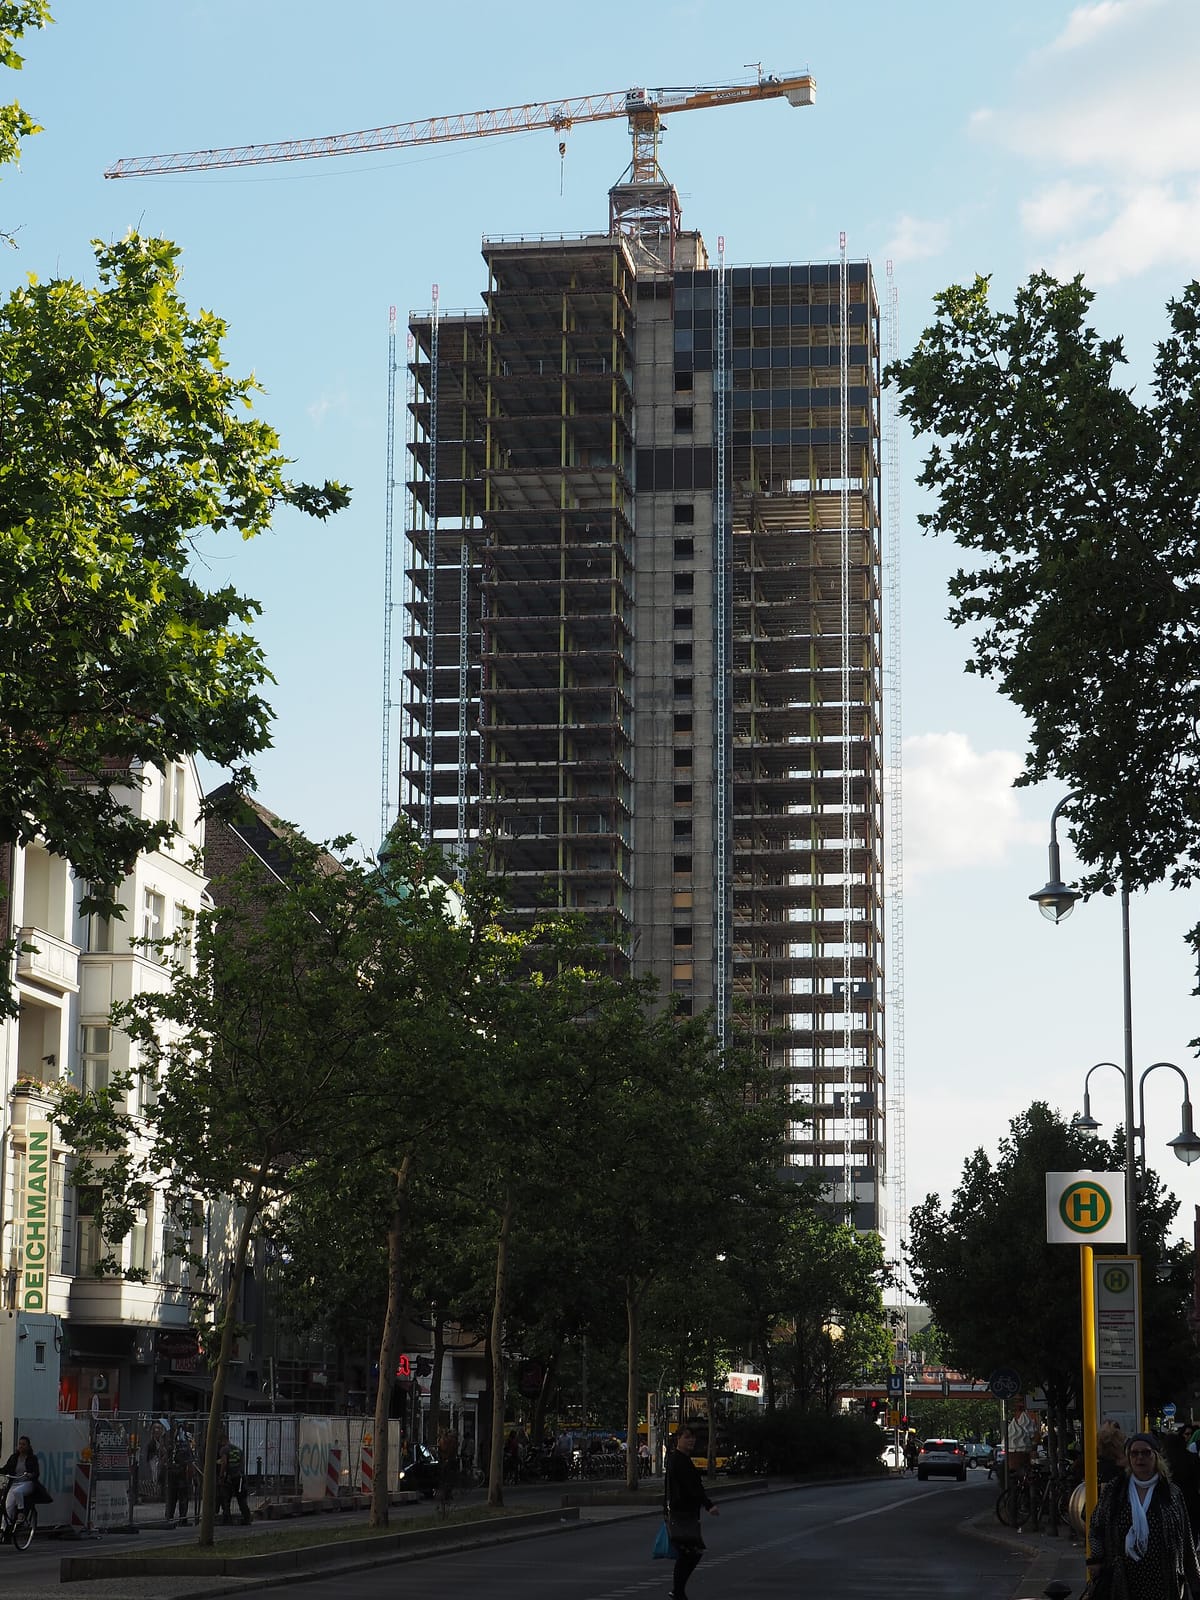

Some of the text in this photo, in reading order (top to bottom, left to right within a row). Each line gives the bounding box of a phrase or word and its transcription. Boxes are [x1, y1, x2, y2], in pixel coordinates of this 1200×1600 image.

[24, 1132, 48, 1309] DEICHMANN
[1073, 1194, 1098, 1221] H
[1111, 1273, 1123, 1289] H
[891, 1378, 901, 1390] U
[37, 1451, 81, 1493] ONE
